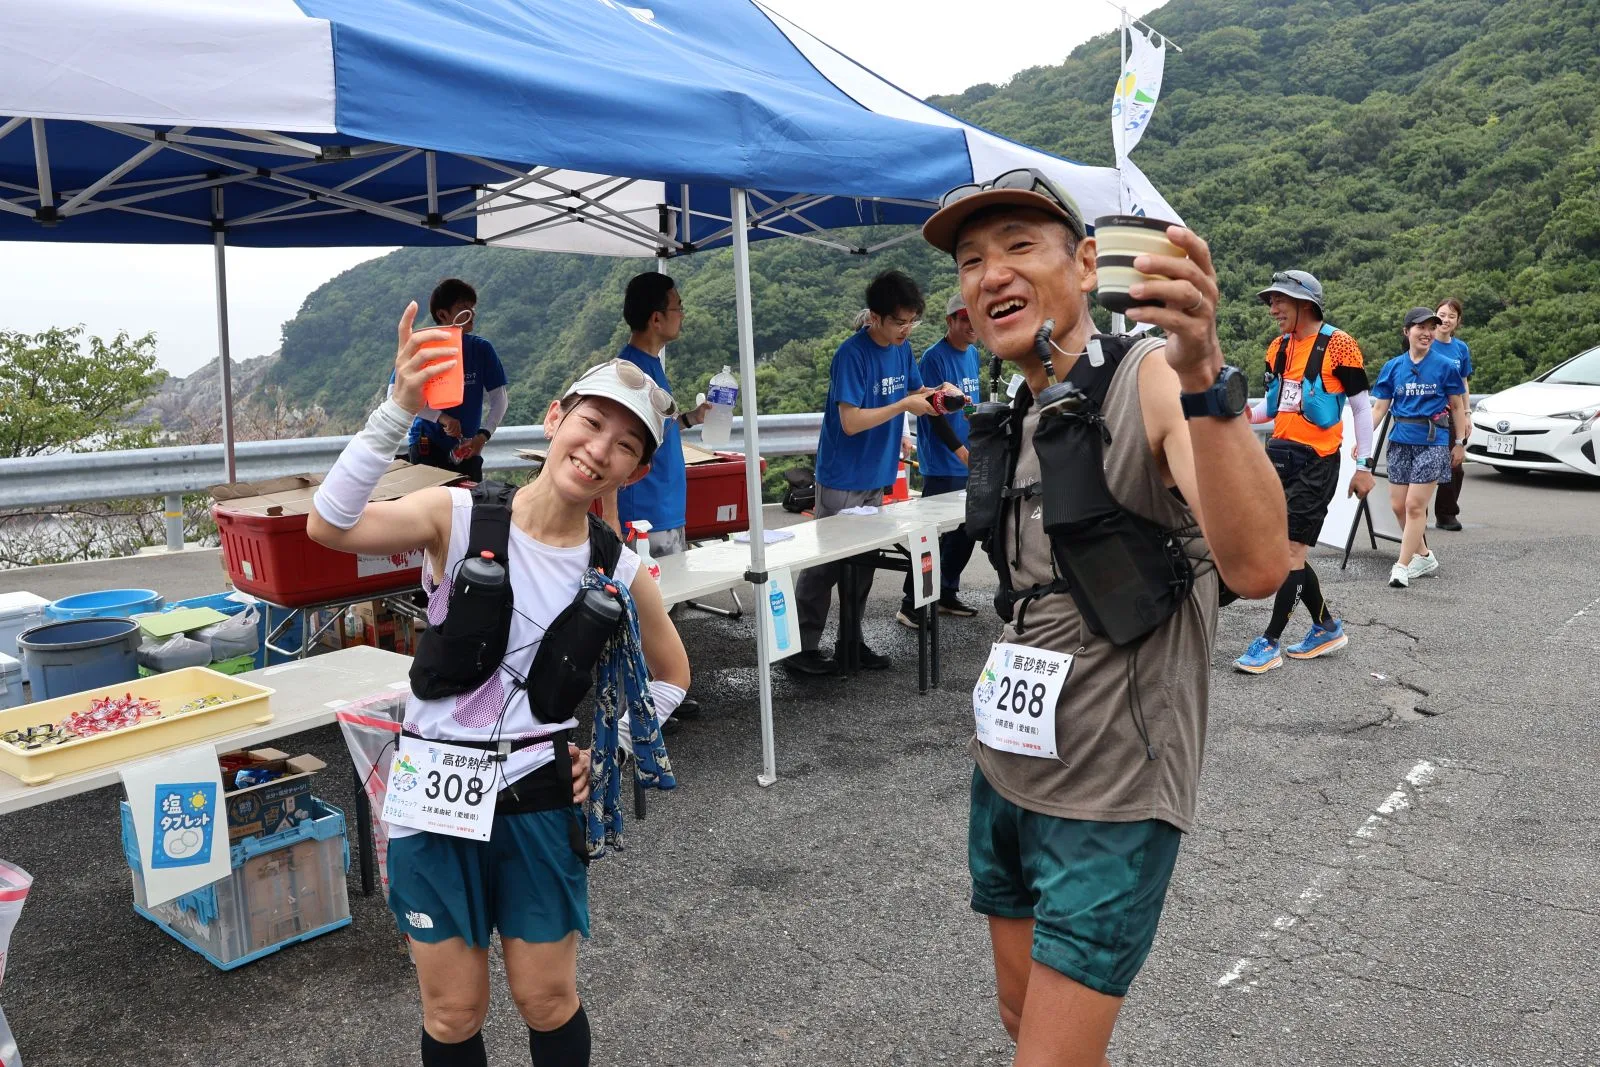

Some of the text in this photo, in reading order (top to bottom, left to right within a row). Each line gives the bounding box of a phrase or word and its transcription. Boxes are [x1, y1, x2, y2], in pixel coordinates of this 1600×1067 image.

[1013, 655, 1060, 676] 高砂熱学
[996, 676, 1047, 719] 268
[442, 753, 493, 772] 高砂熱学
[424, 770, 484, 807] 308
[162, 794, 183, 815] 塩
[160, 813, 211, 831] タブレット
